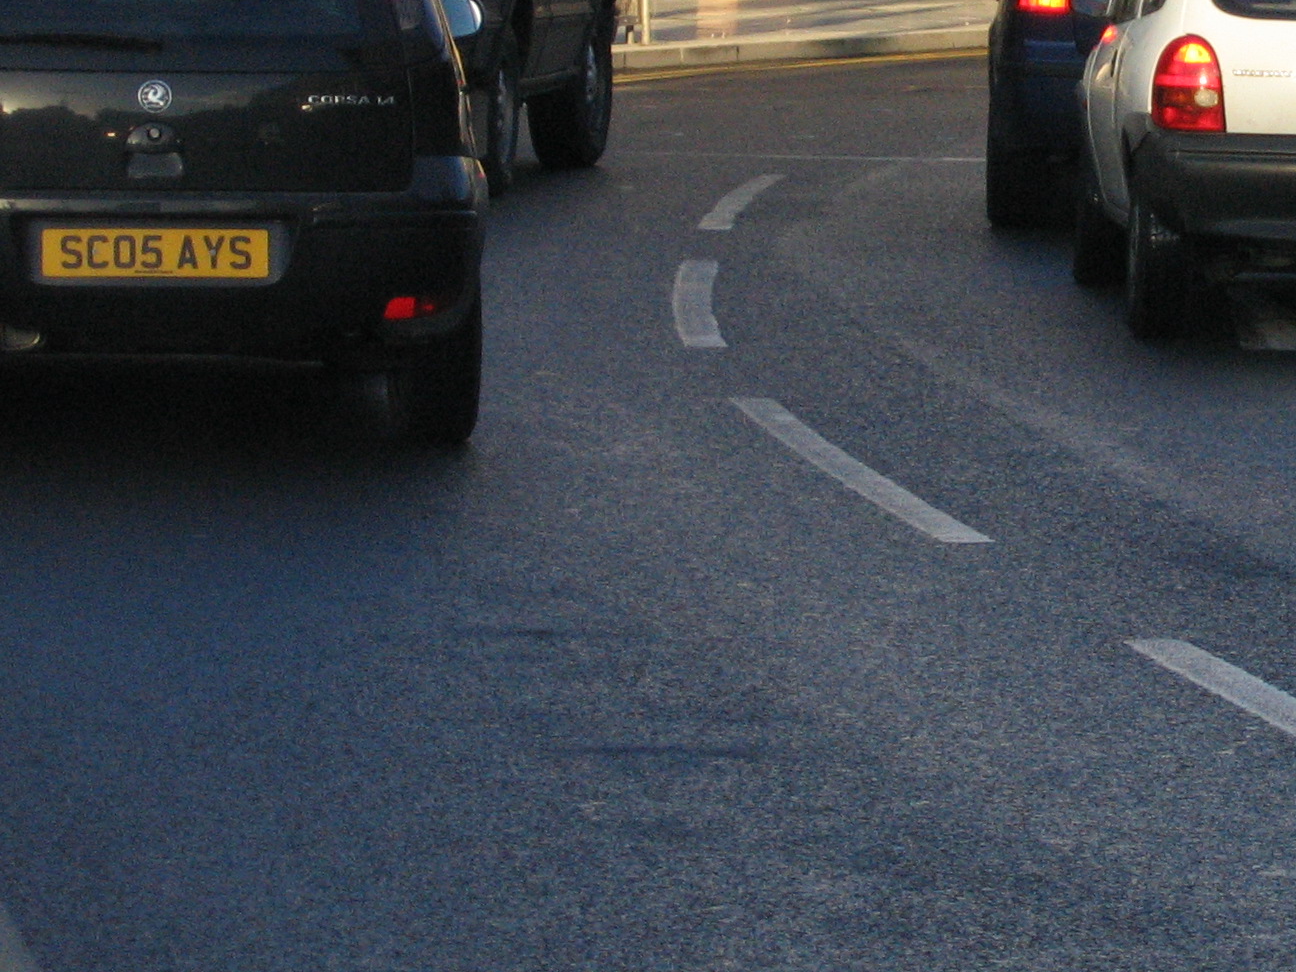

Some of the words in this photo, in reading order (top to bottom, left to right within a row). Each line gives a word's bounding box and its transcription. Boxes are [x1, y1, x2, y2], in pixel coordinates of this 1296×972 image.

[308, 95, 370, 105] CORSA
[60, 234, 163, 270] SC05
[177, 234, 253, 270] AYS
